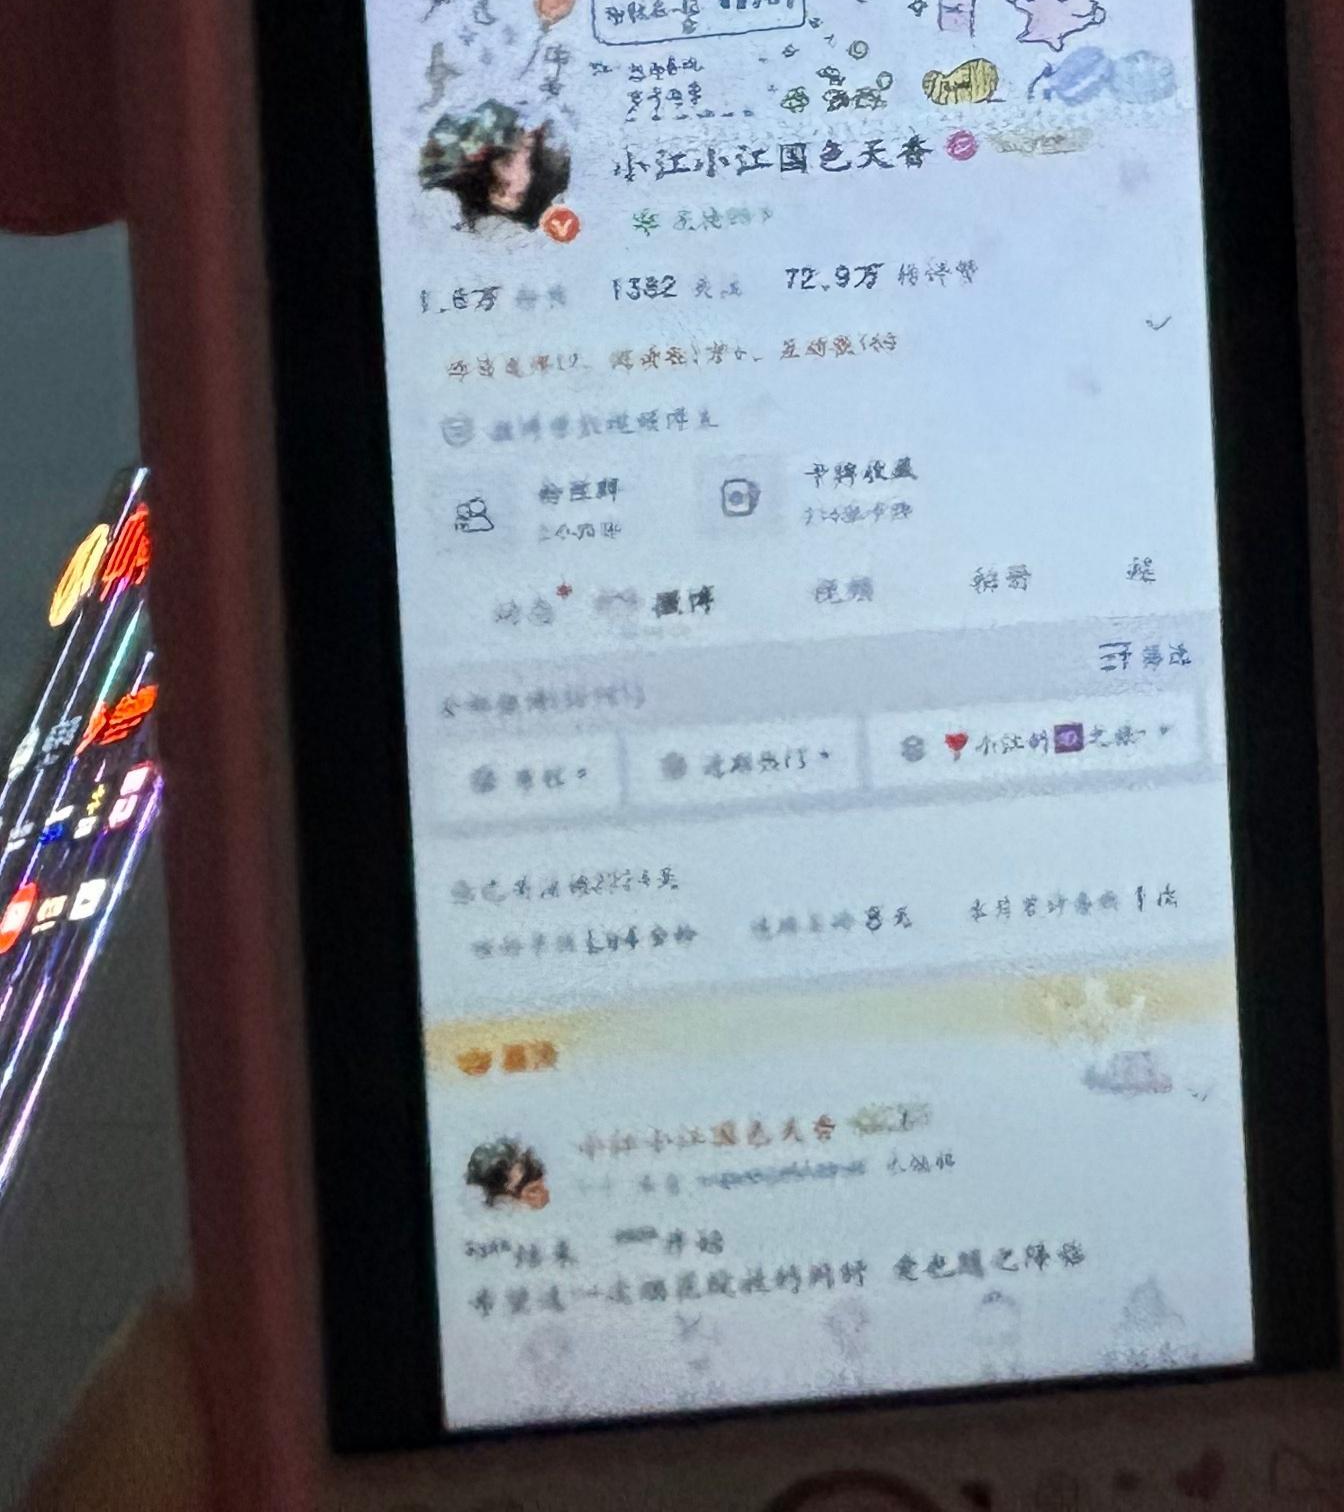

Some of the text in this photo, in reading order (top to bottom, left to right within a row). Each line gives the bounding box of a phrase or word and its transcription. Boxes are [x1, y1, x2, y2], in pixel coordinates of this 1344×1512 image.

[613, 132, 934, 182] 小江小江国色天香
[612, 274, 678, 301] 1382
